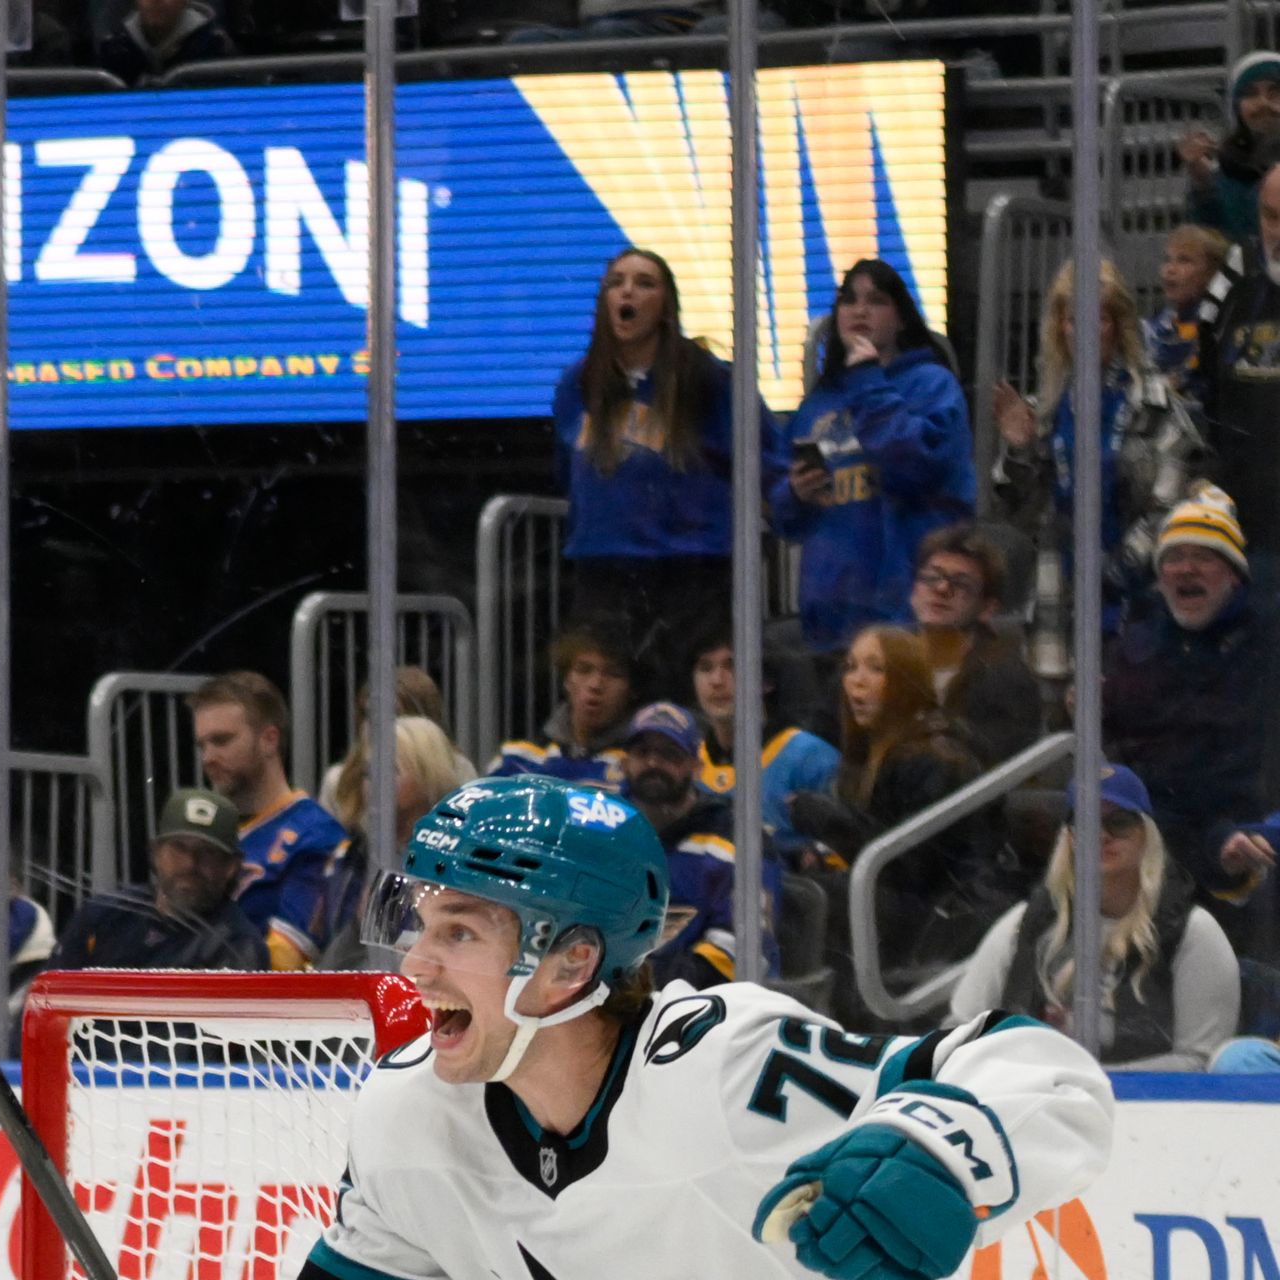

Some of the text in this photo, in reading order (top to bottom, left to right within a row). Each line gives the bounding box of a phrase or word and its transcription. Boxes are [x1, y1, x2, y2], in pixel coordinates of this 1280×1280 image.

[568, 796, 627, 829] SAP
[415, 828, 461, 851] CCM
[747, 1016, 898, 1125] 72
